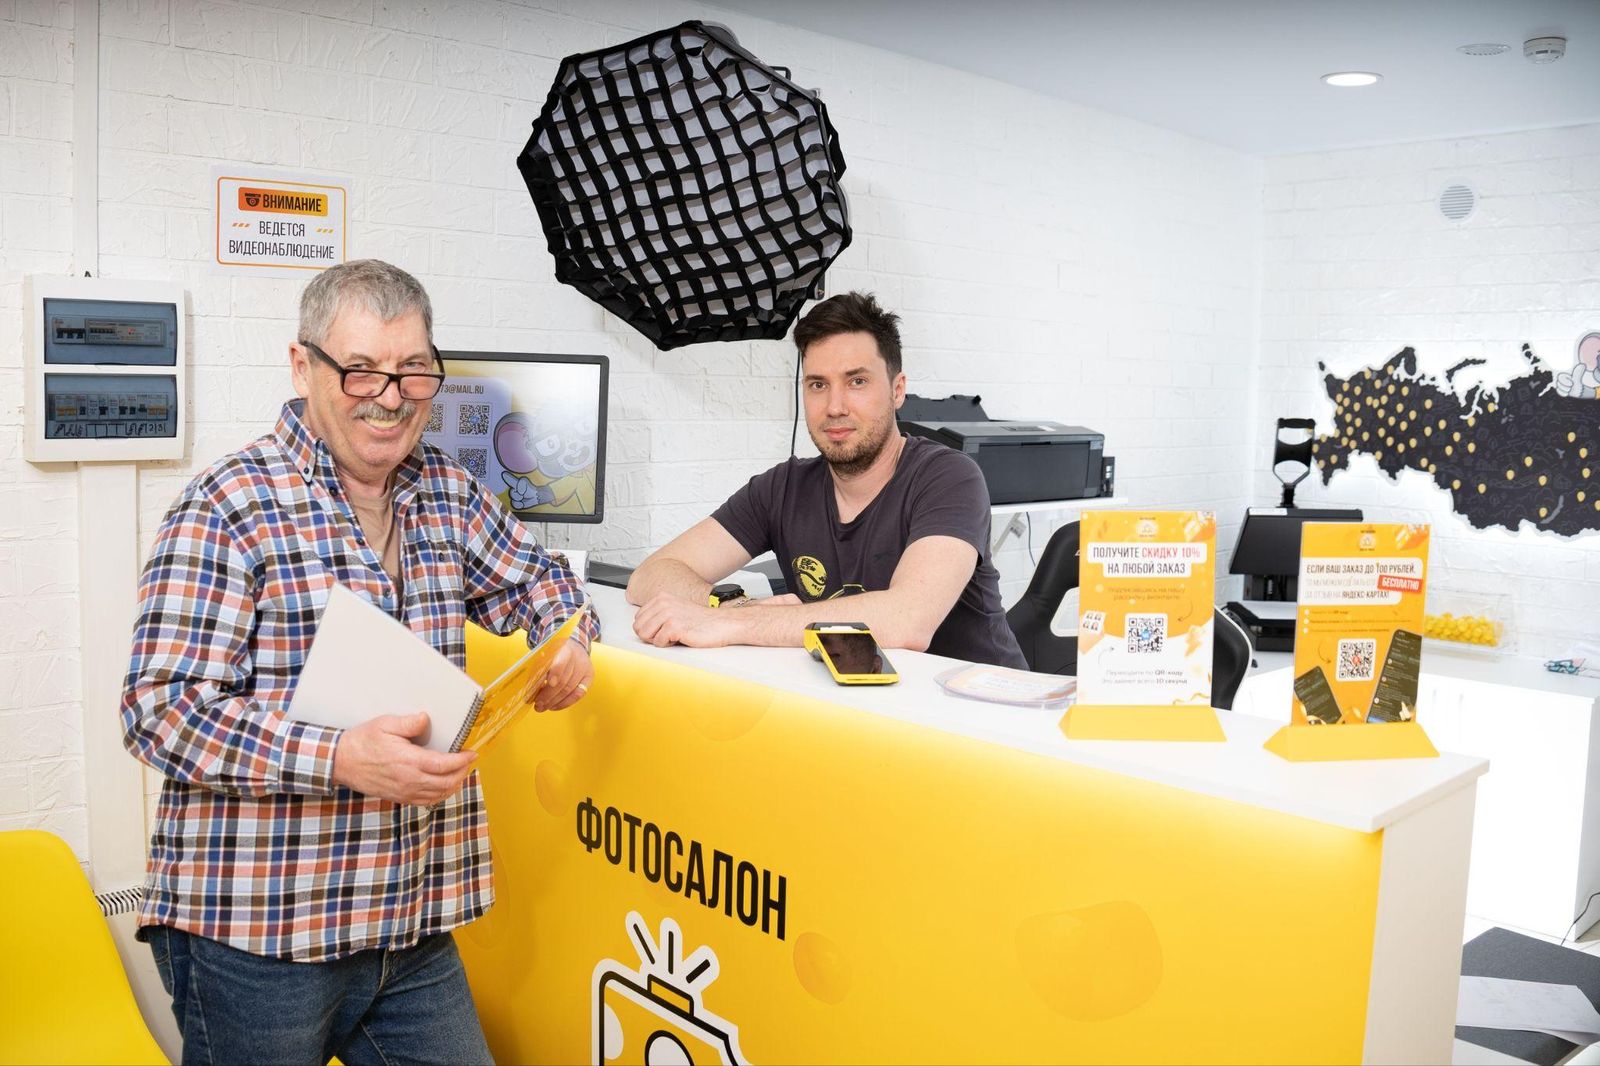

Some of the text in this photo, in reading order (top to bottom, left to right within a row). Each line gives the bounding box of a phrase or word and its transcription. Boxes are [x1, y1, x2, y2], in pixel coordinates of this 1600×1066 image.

[262, 194, 322, 212] ВНИМАНИЕ
[259, 221, 305, 237] ВЕДЕТСЯ
[229, 240, 335, 259] ВИДЕОНАБЛЮДЕНИЕ
[1093, 547, 1201, 559] ПОЛУЧИТЕ СКИДКУ 10%
[1107, 561, 1186, 574] НА ЛЮБОЙ ЗАКАЗ
[1306, 565, 1325, 574] ЕСЛИ
[1326, 565, 1341, 574] ВАШ
[1342, 565, 1363, 574] ЗАКАЗ
[1364, 565, 1374, 574] ДО
[1381, 577, 1420, 591] БЕСПЛАТНО
[576, 797, 787, 941] ФОТОСАЛОН
